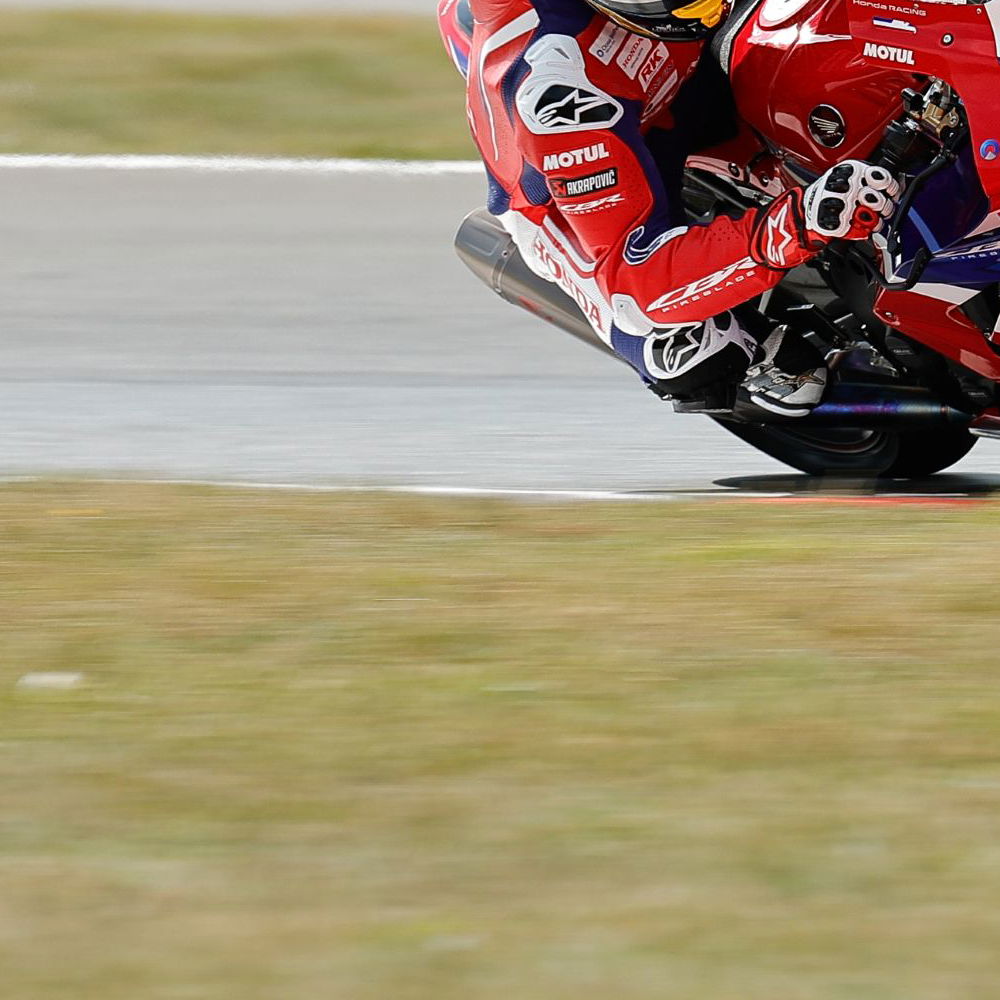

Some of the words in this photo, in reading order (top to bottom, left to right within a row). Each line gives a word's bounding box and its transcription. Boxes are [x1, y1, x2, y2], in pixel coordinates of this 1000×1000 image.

[888, 4, 927, 16] RACING
[642, 49, 664, 82] RK
[863, 42, 915, 65] MOTUL
[543, 143, 610, 171] MOTUL
[646, 255, 758, 313] CBR
